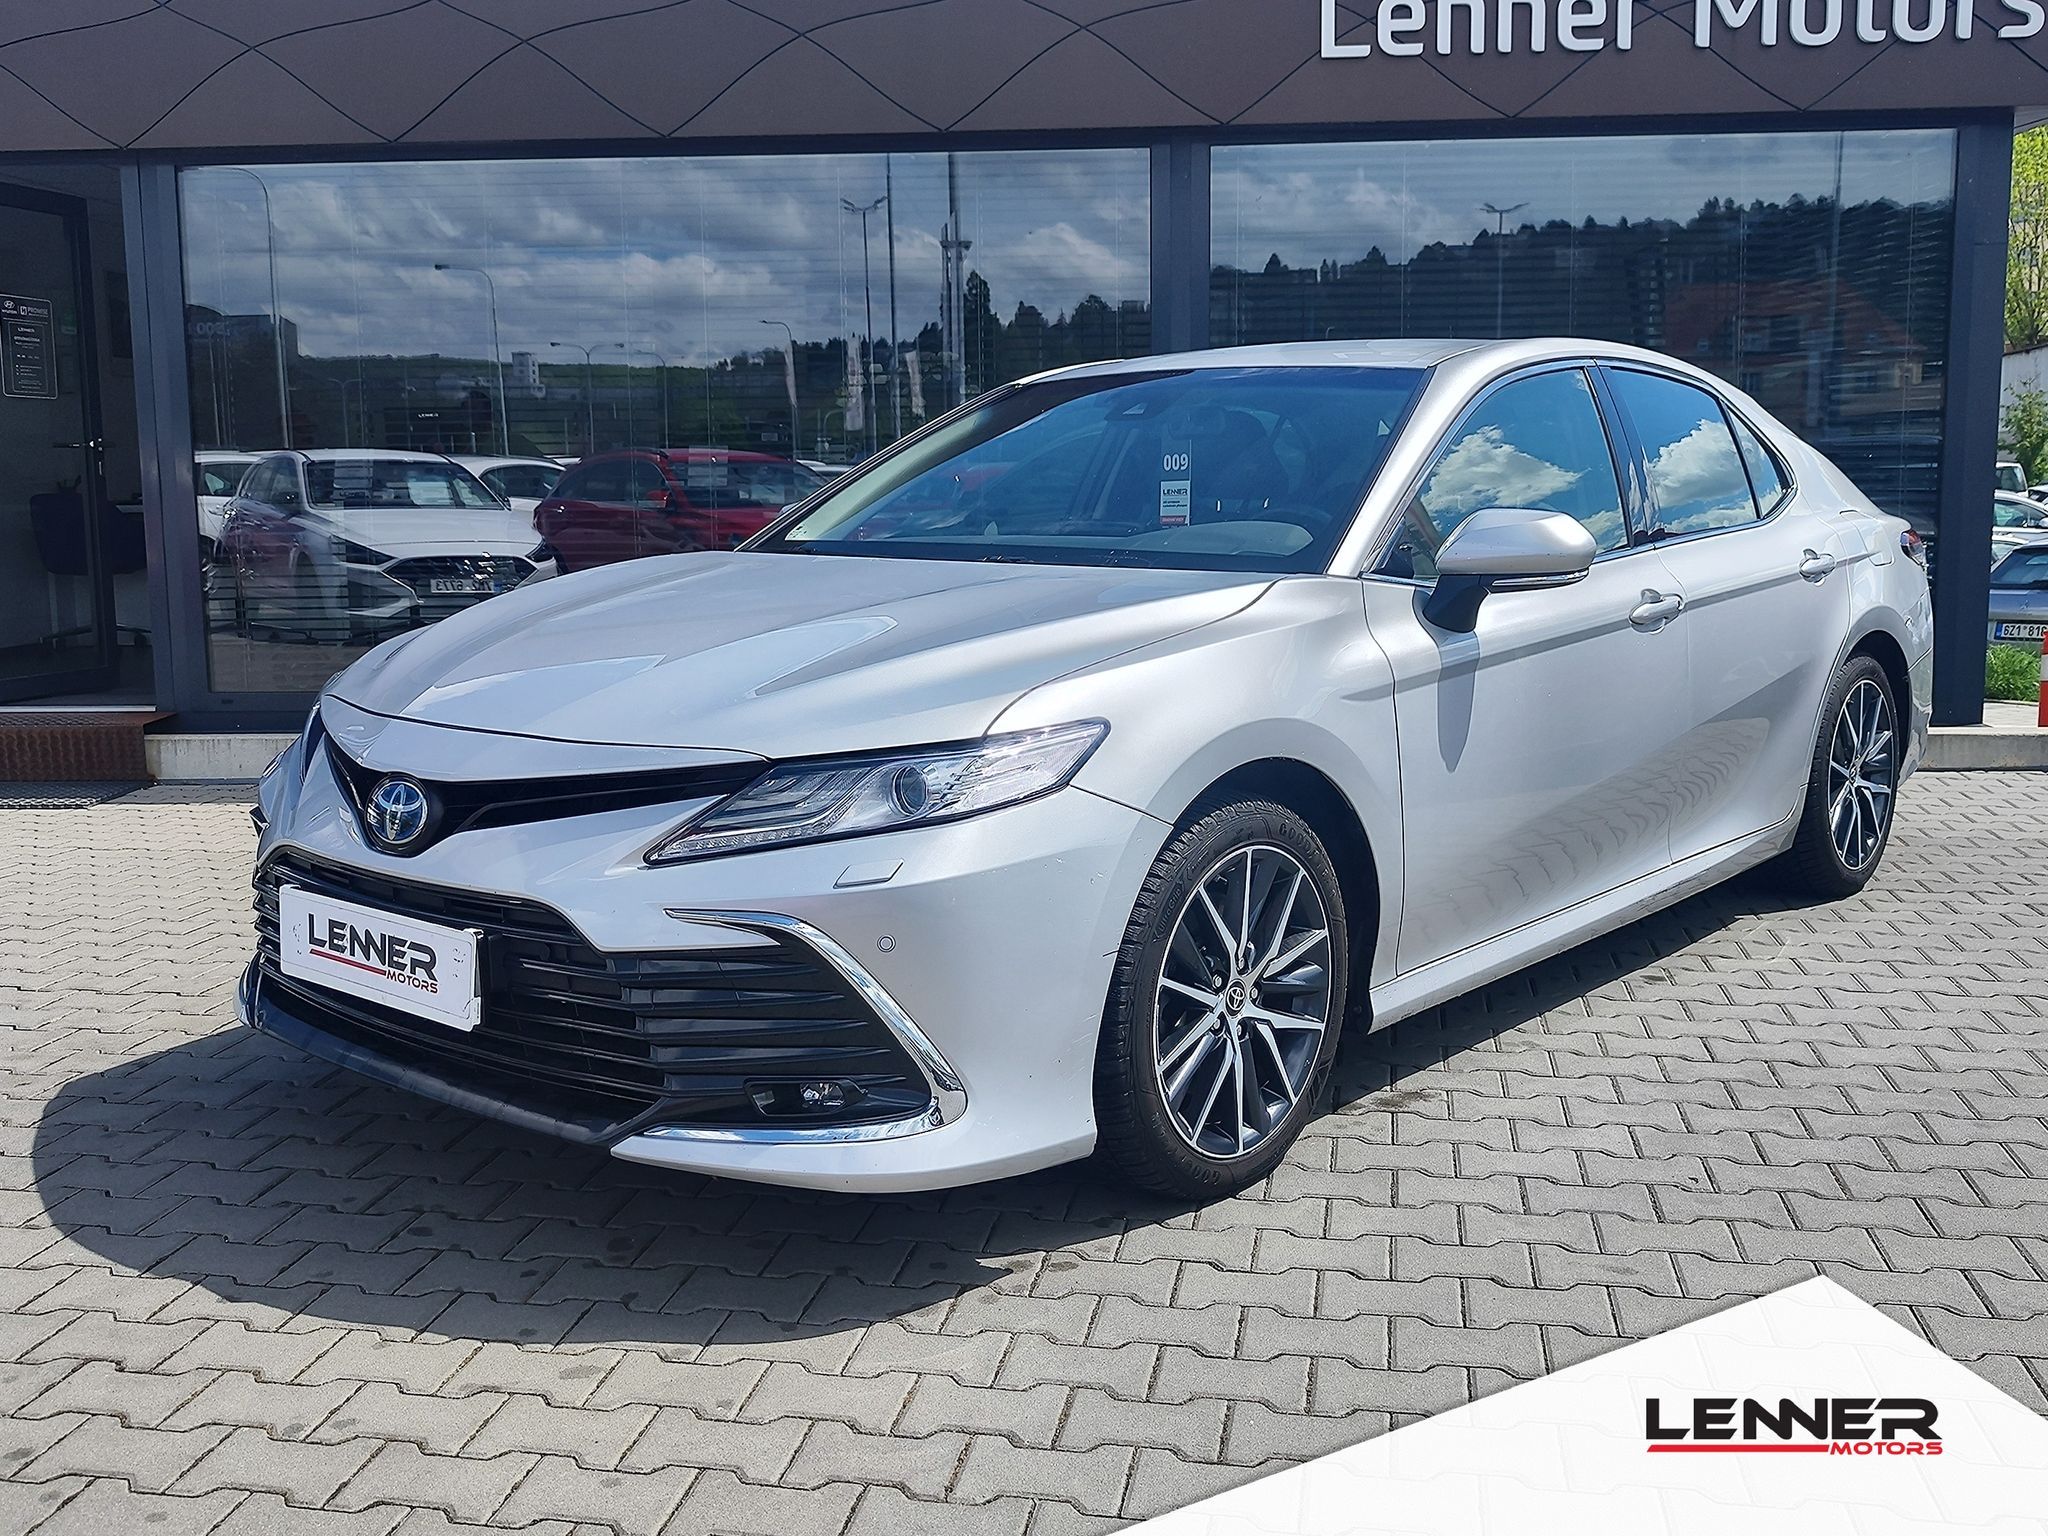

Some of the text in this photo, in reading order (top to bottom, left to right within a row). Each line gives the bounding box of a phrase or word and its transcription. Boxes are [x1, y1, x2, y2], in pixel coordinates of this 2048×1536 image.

[1163, 453, 1189, 471] 009
[2003, 624, 2021, 637] 6Z1
[308, 913, 438, 982] LENNER
[386, 969, 439, 994] MOTORS
